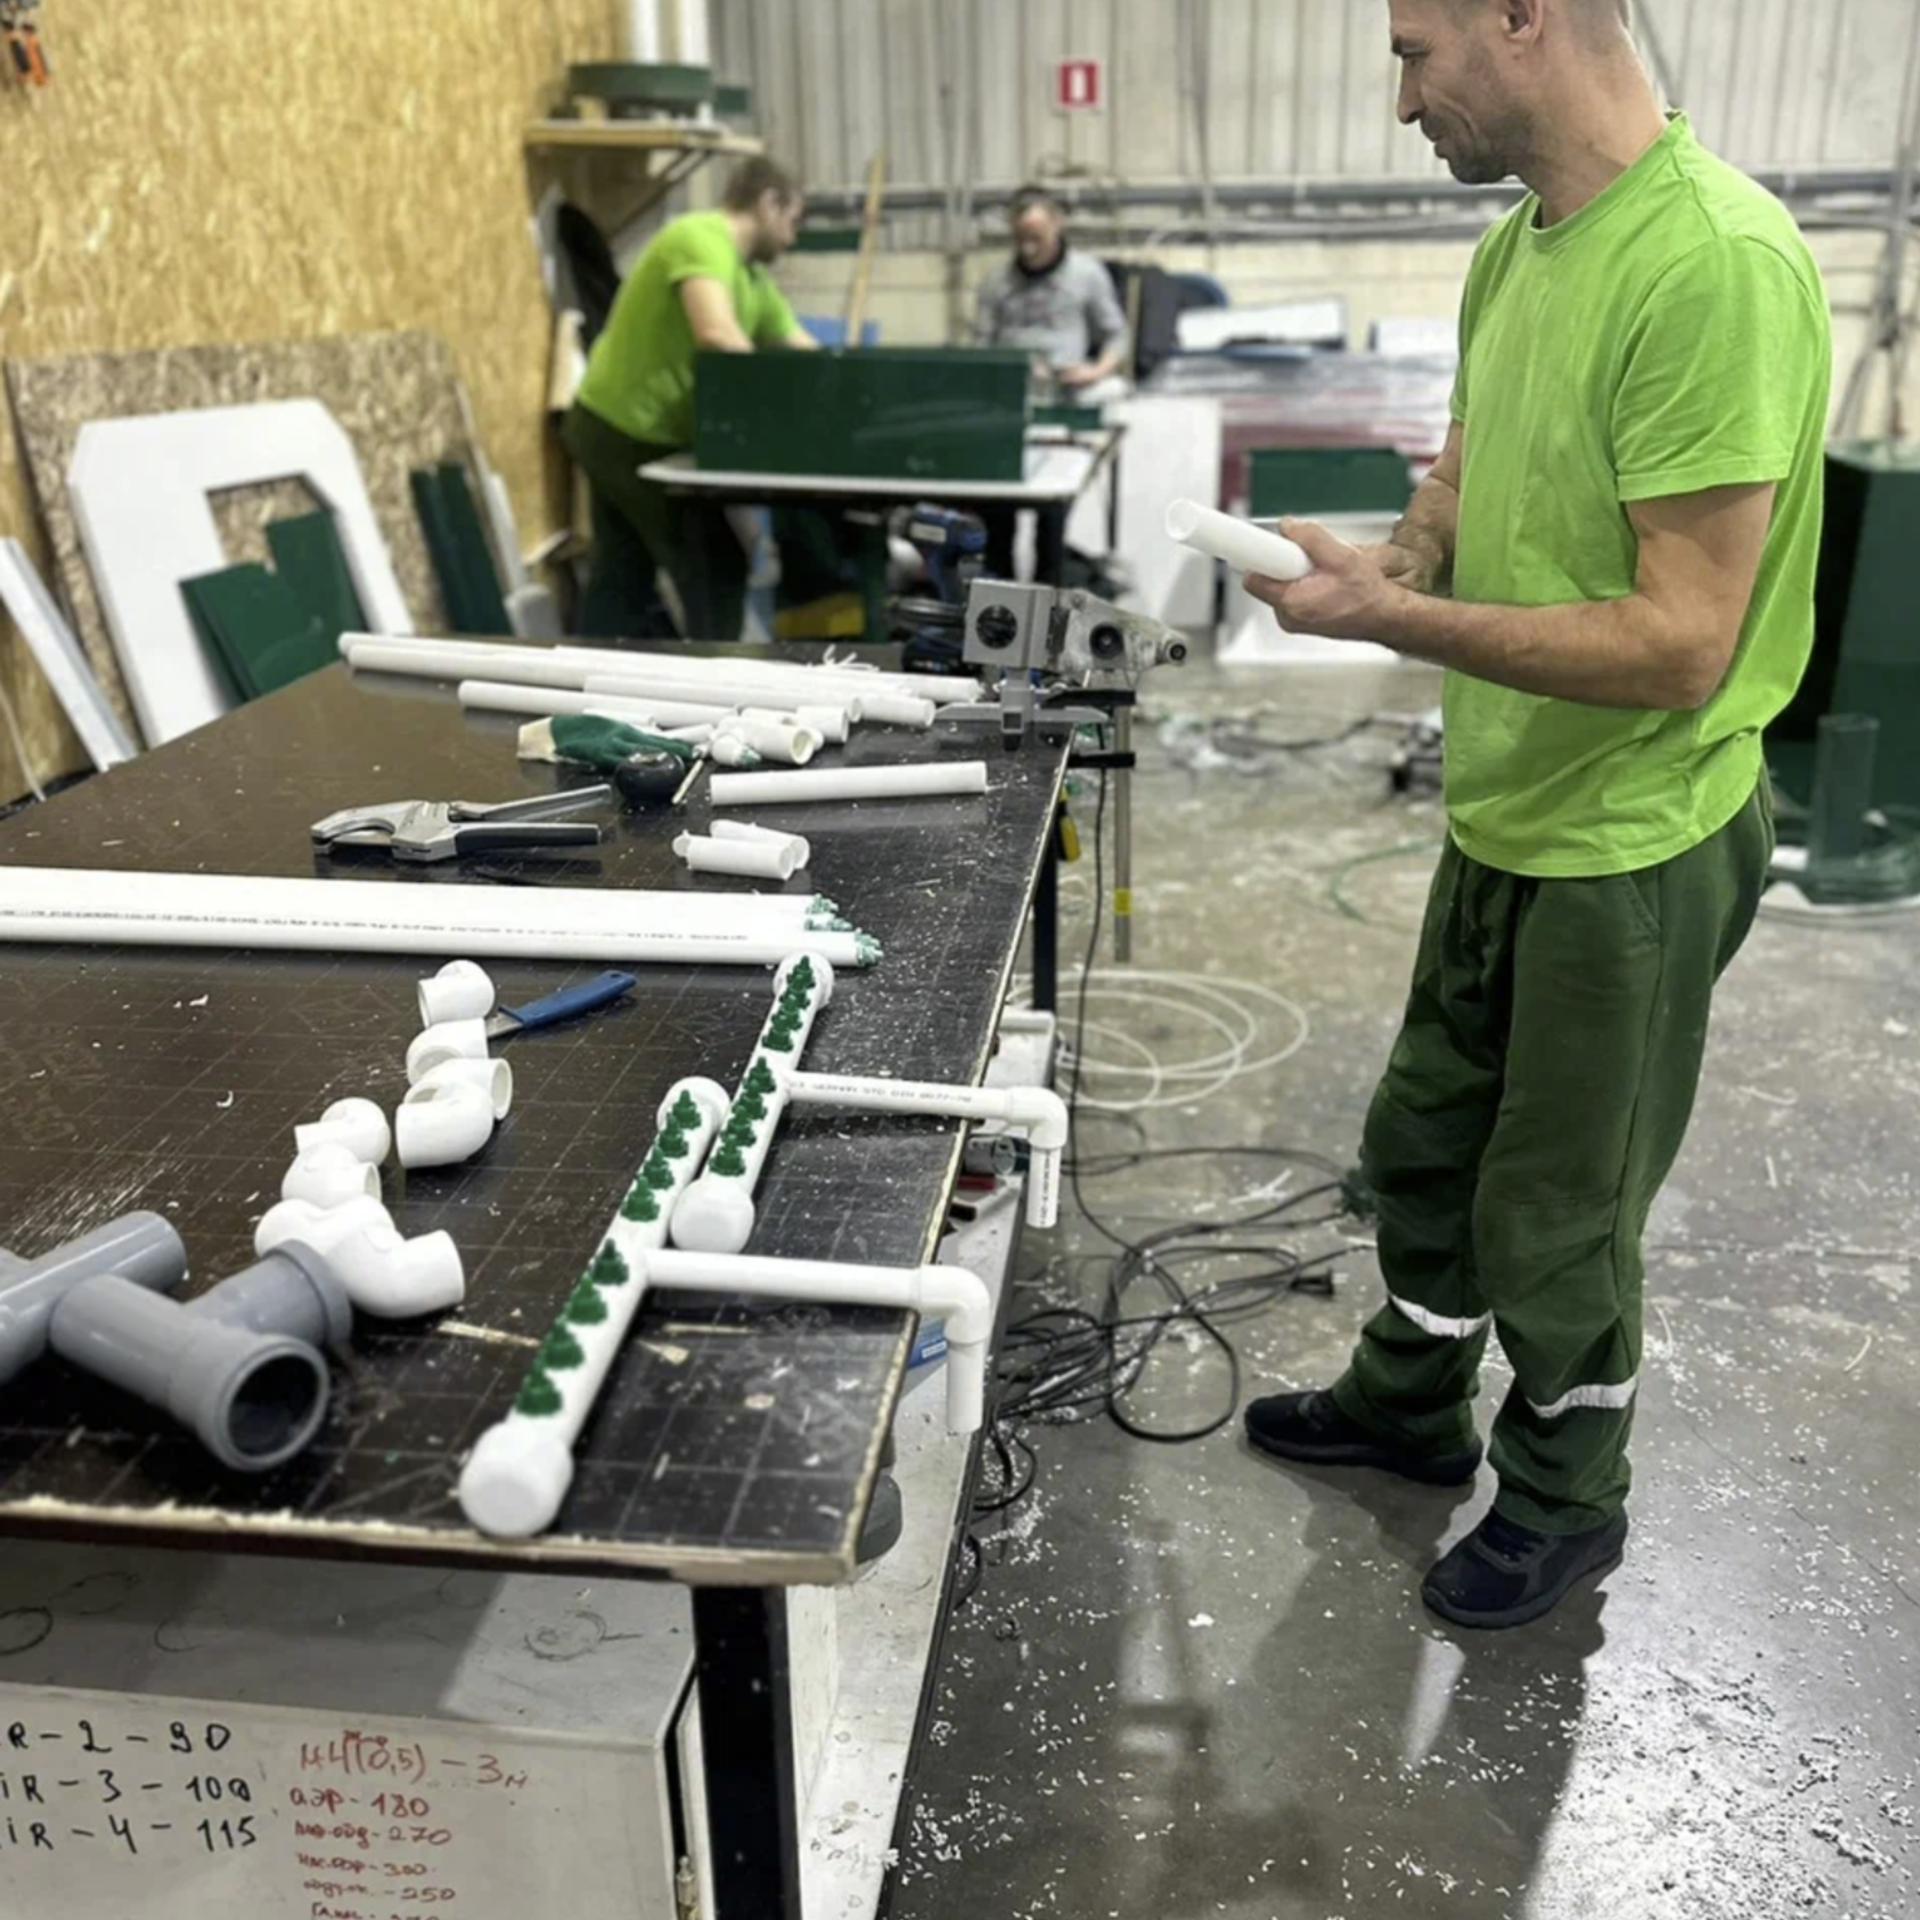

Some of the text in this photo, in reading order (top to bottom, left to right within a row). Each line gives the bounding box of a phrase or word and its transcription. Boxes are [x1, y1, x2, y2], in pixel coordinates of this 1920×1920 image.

[97, 1769, 122, 1803] 3
[371, 1793, 429, 1818] 180
[0, 1817, 54, 1850] iR
[108, 1814, 137, 1854] 4
[197, 1815, 256, 1852] 115
[389, 1826, 451, 1845] 270
[401, 1887, 456, 1903] 250
